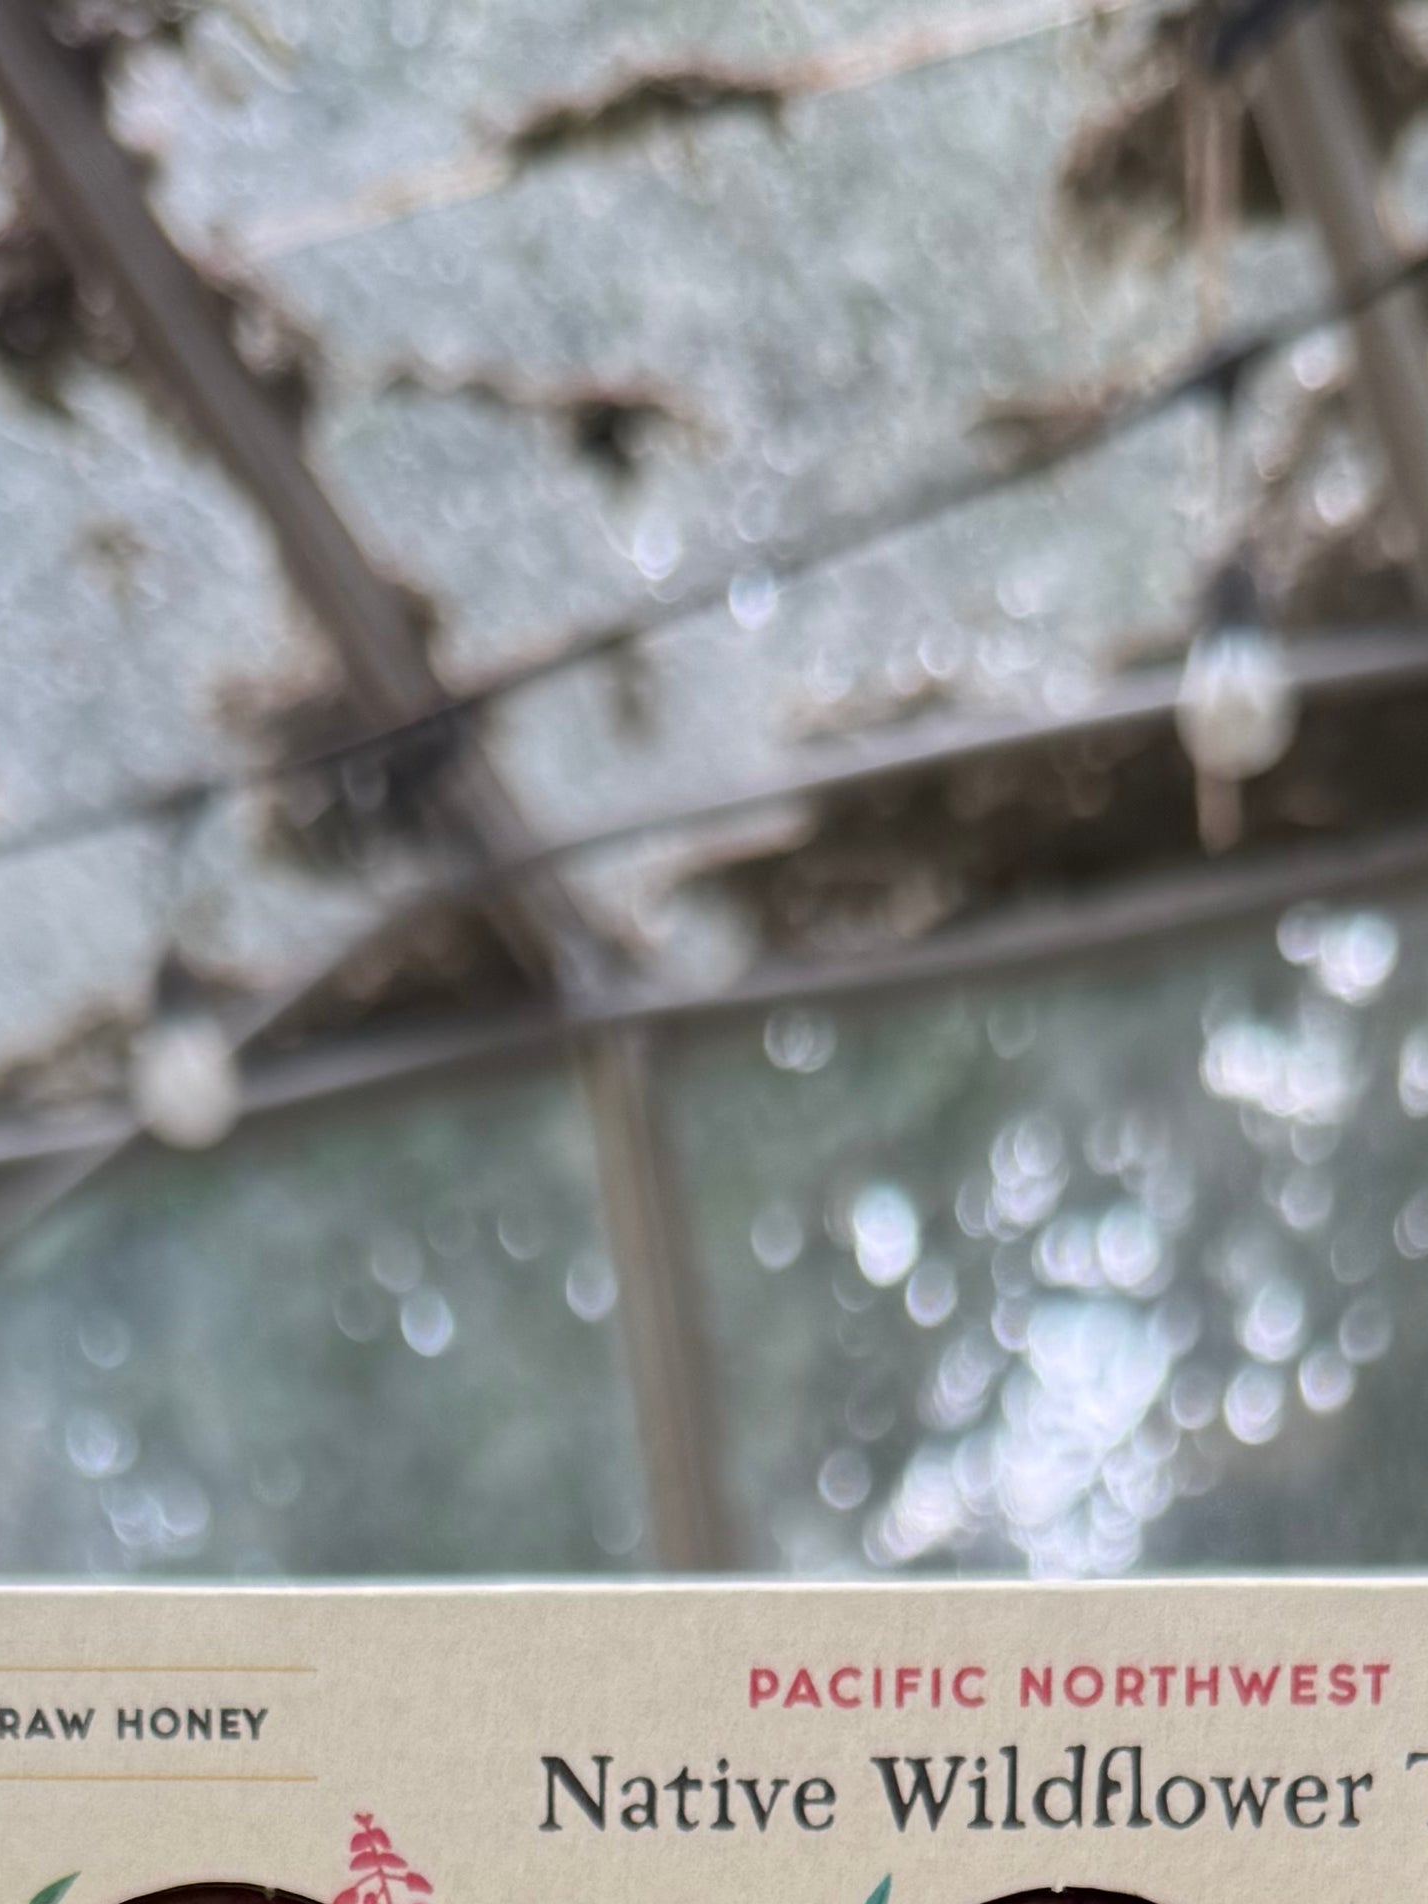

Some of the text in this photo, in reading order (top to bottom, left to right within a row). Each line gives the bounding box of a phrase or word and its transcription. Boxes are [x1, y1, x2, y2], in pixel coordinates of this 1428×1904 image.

[751, 1663, 1391, 1708] PACIFIC NORTHWEST
[117, 1707, 269, 1741] HONEY
[539, 1755, 838, 1831] Native
[873, 1744, 1373, 1831] Wildflower
